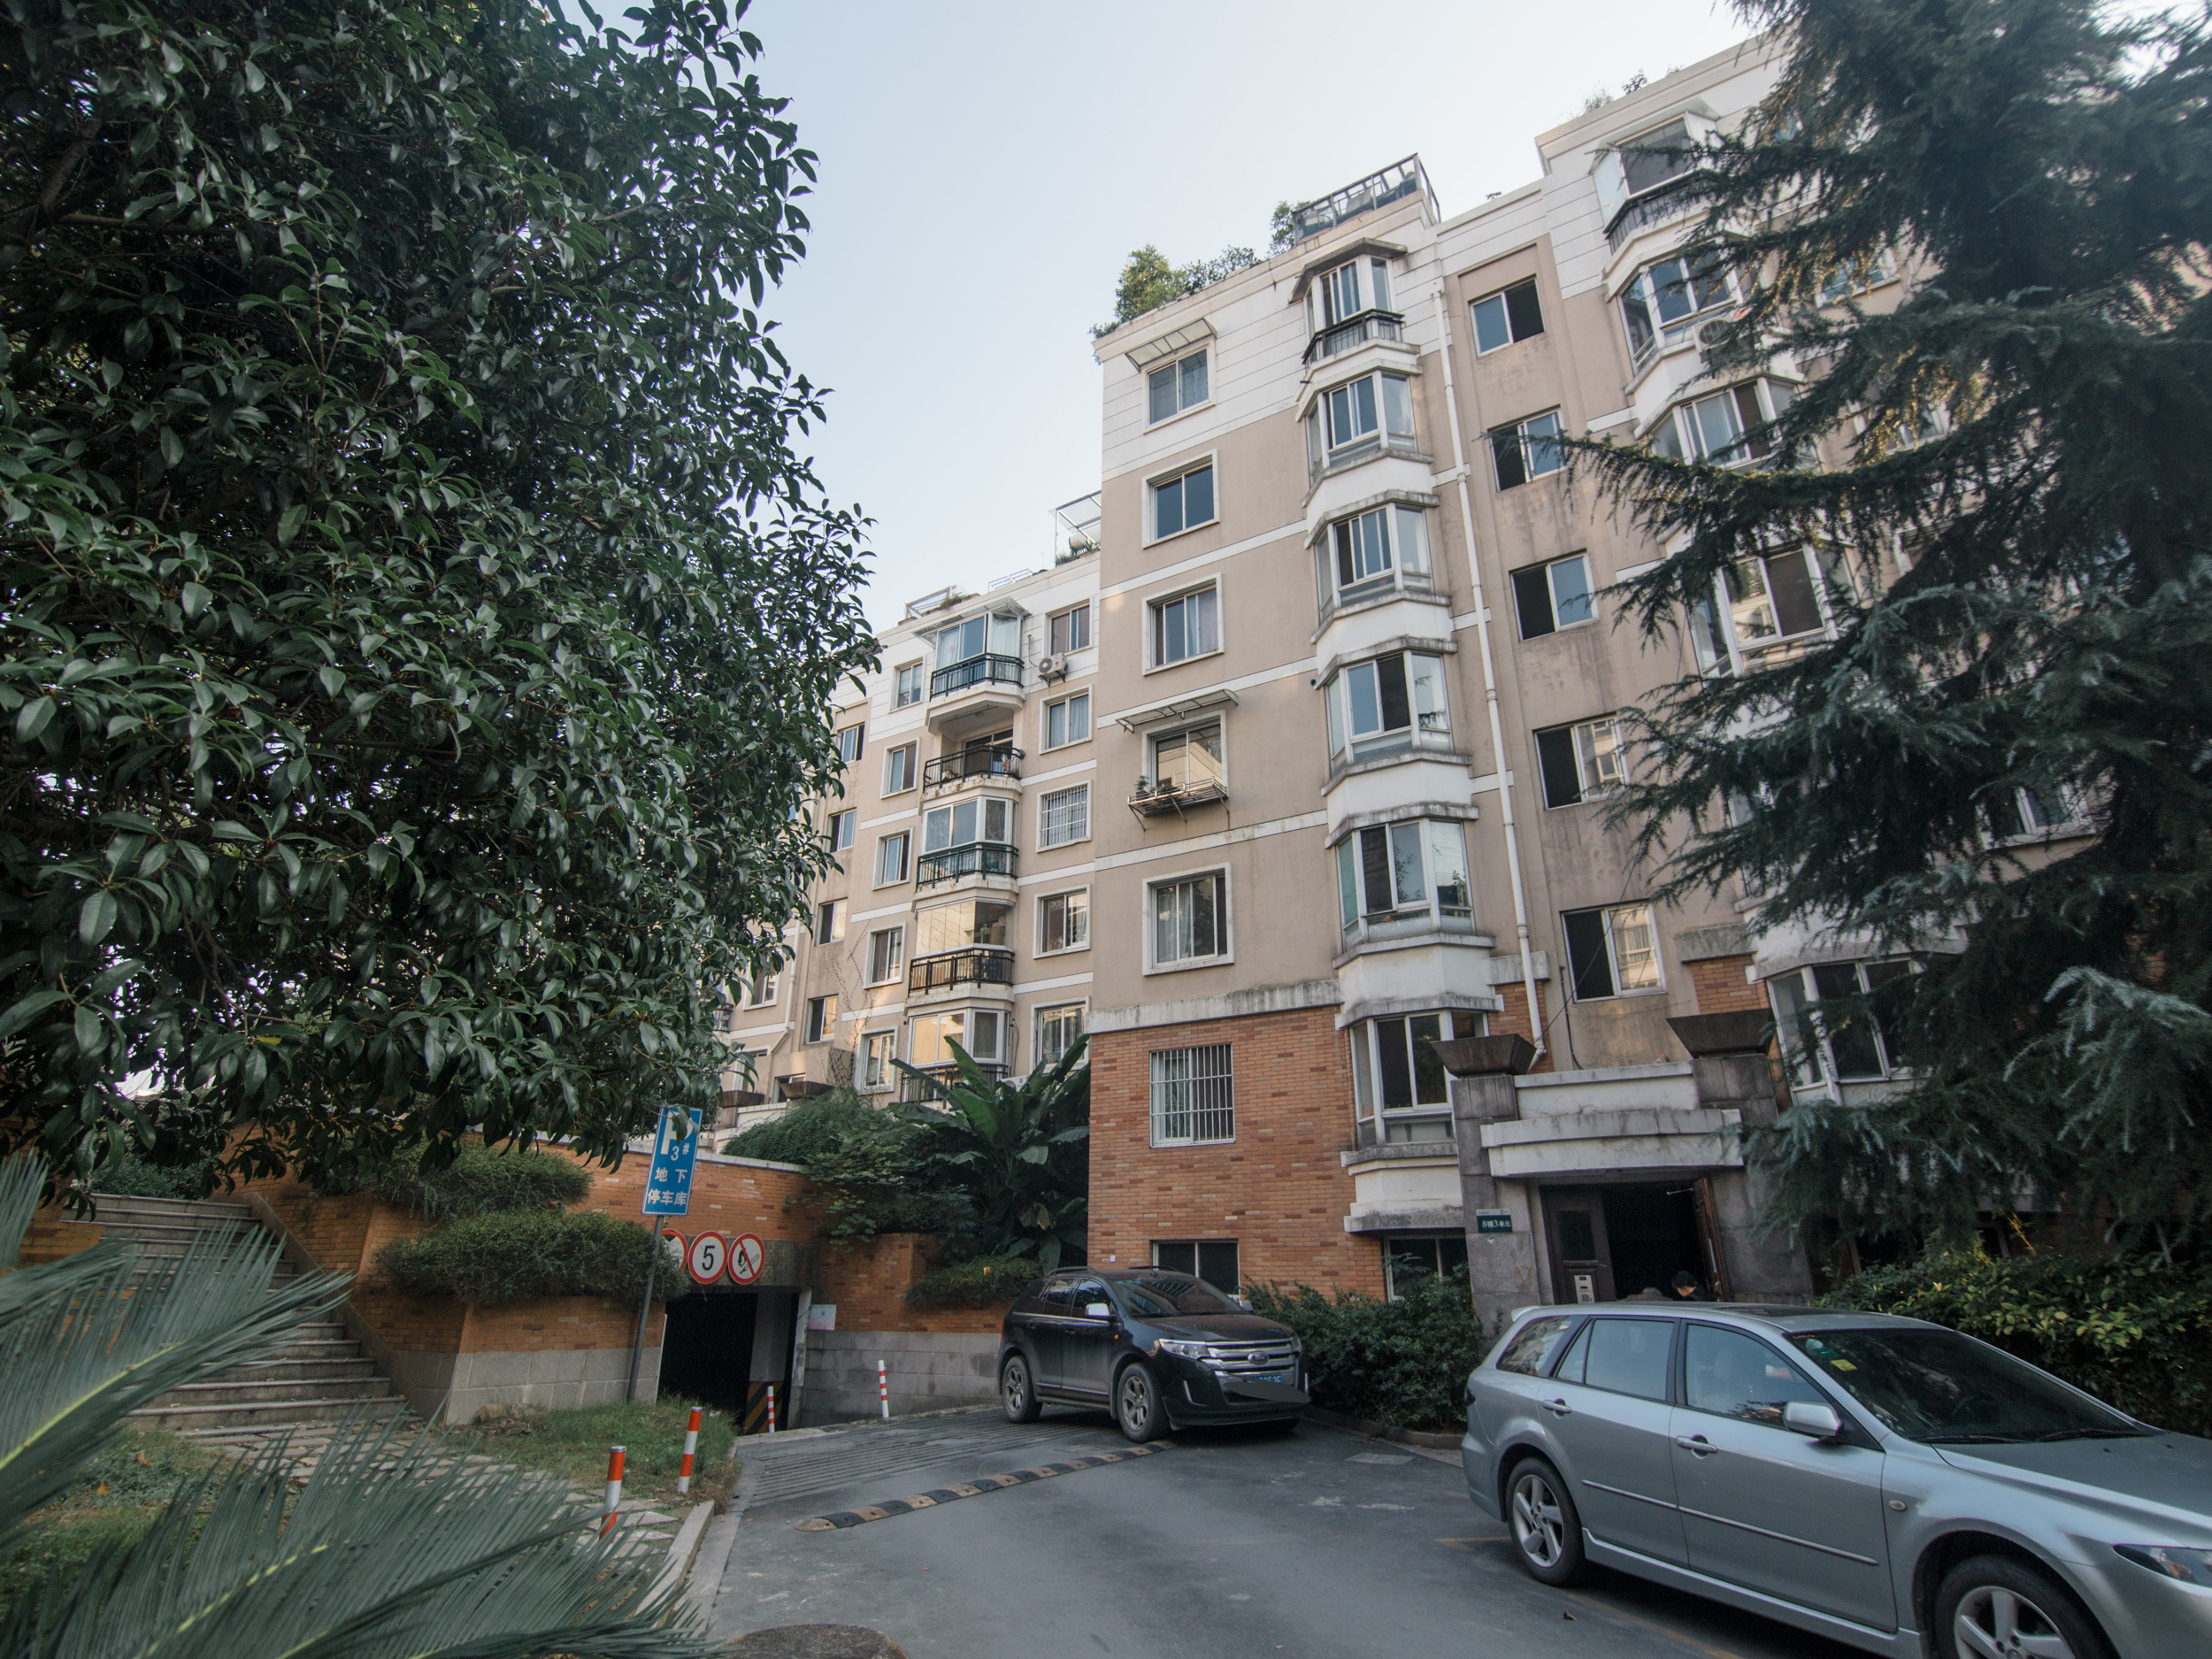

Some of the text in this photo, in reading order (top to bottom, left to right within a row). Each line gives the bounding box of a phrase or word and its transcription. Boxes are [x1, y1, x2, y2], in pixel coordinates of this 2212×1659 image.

[660, 1110, 693, 1155] P
[655, 1167, 687, 1183] 地下
[647, 1188, 687, 1206] 停车库
[702, 1245, 715, 1271] 5
